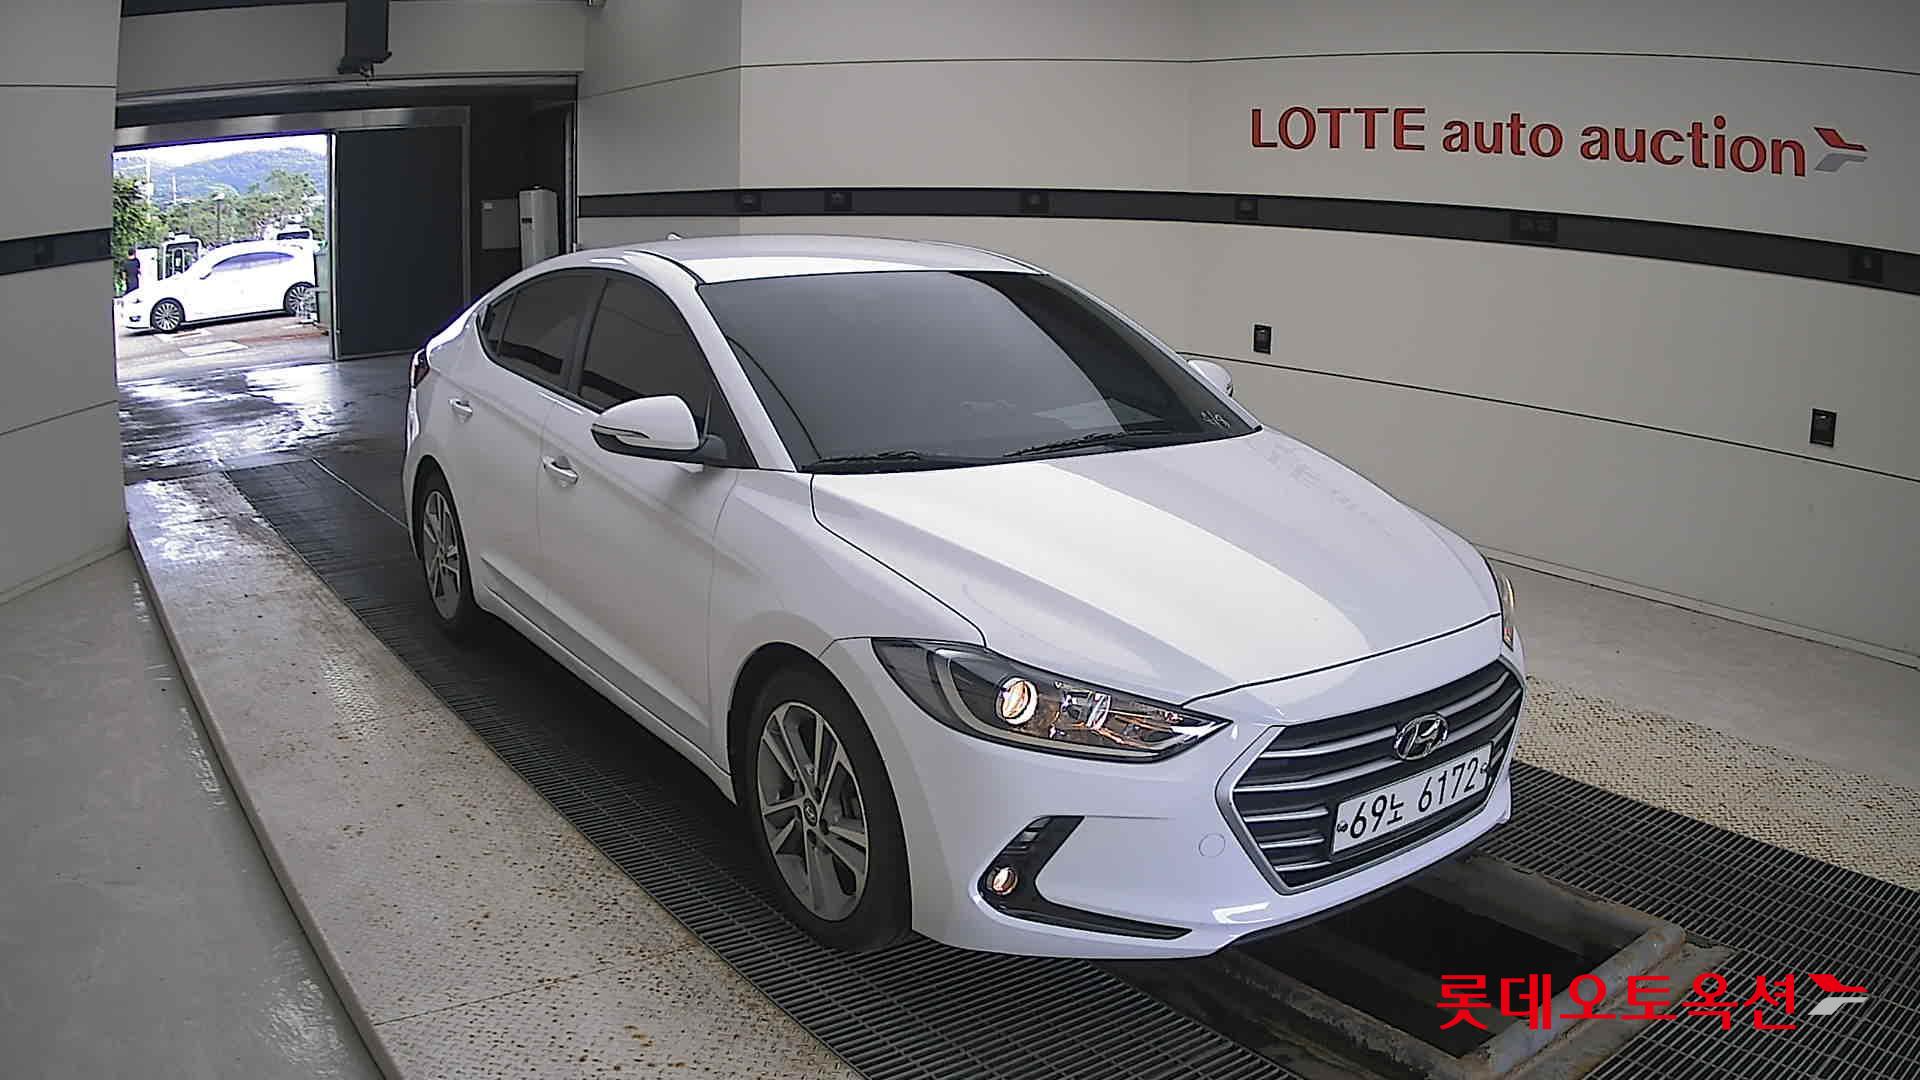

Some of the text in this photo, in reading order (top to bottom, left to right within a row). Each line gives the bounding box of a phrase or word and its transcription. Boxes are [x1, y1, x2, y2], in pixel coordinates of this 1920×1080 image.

[1250, 106, 1807, 177] LOTTE auto auction
[1350, 757, 1479, 839] 69노 6172
